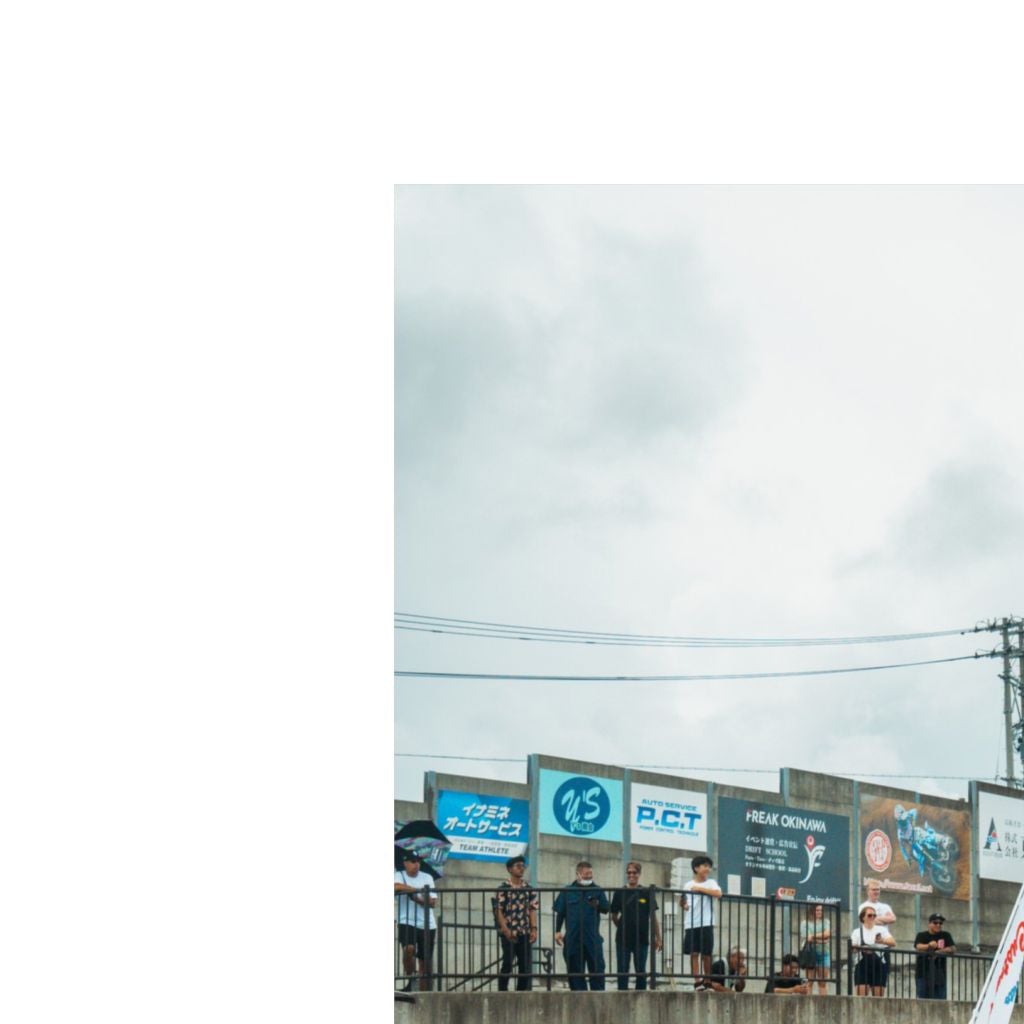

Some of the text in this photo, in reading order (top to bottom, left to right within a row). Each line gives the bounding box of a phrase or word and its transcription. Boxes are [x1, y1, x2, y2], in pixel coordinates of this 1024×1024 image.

[462, 803, 511, 820] イナミネ
[642, 799, 697, 812] AUTO SERVICE
[443, 816, 523, 837] オートサービス
[636, 805, 702, 830] P.C.T
[745, 809, 827, 833] FREAK OKINAWA
[459, 843, 478, 851] TEAM
[480, 845, 510, 854] ATHLETE
